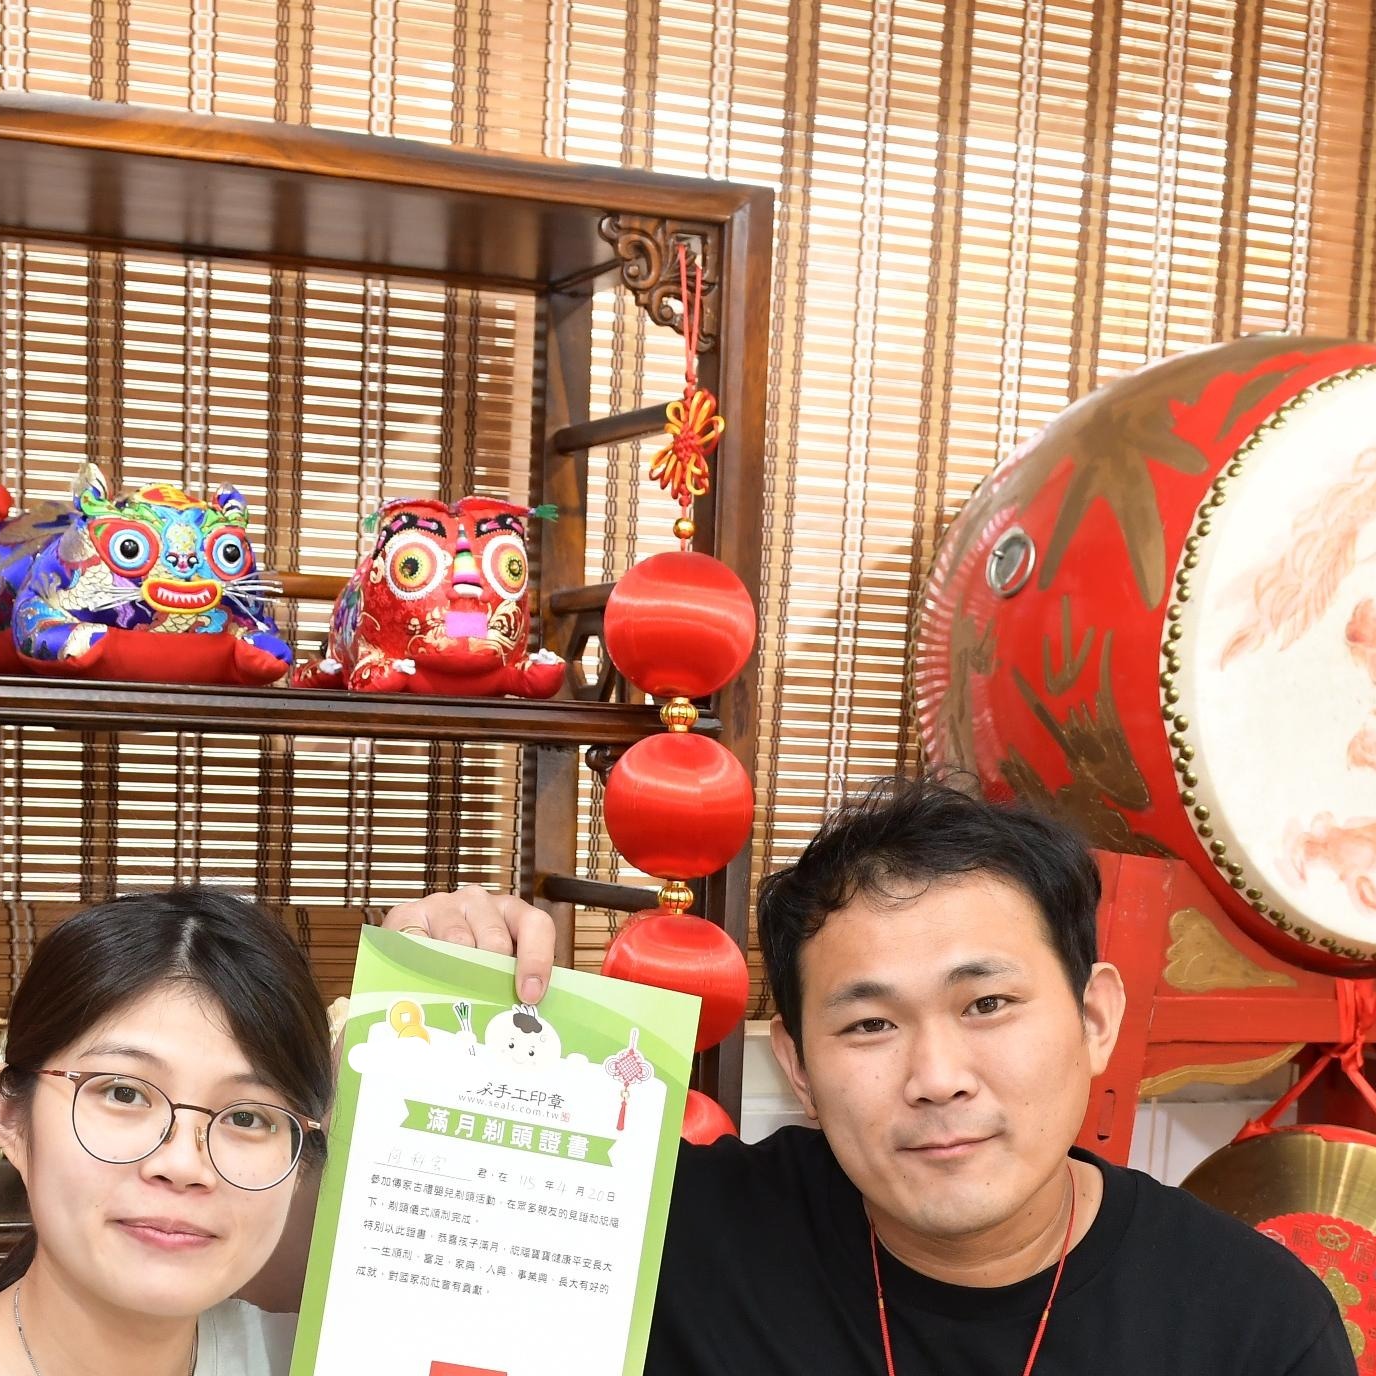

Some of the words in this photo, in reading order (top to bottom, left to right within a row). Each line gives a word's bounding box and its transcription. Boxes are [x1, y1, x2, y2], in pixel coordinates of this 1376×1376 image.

[458, 1094, 560, 1119] www.seals.com.tw
[425, 1107, 590, 1160] 滿月剃頭證書
